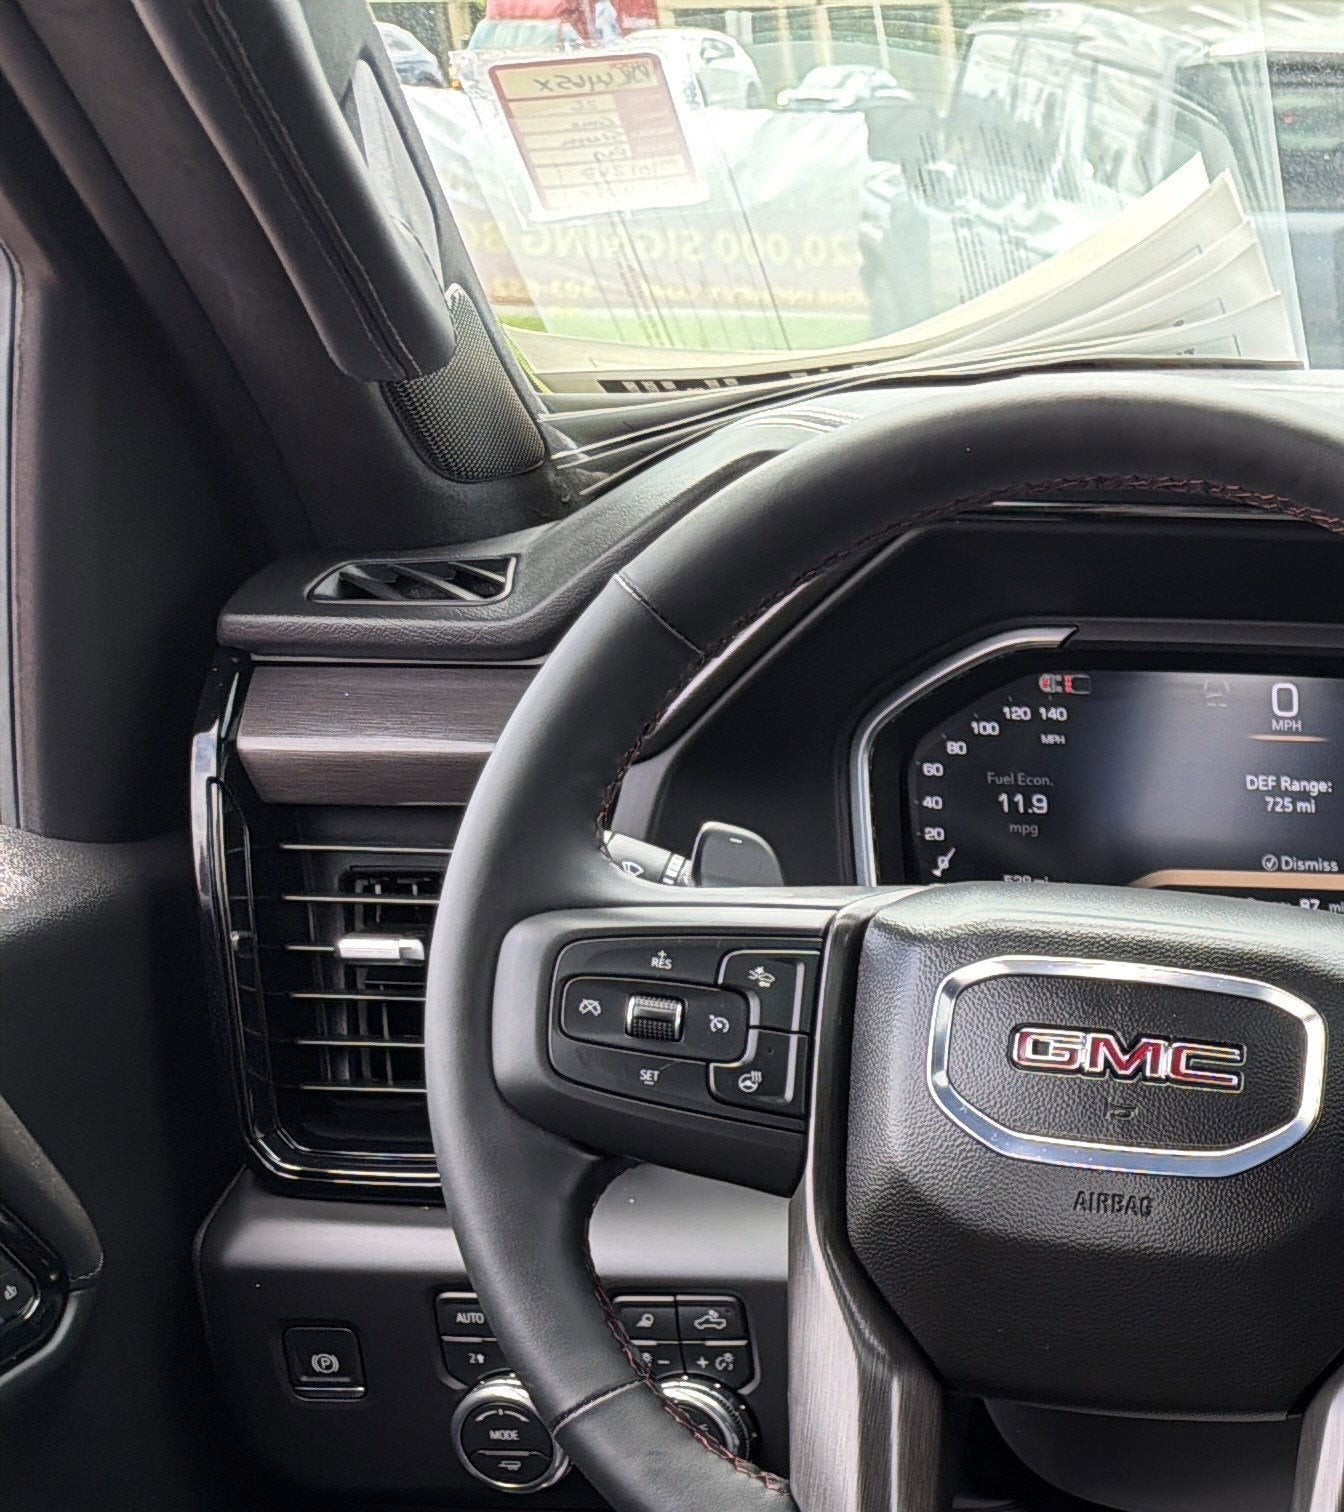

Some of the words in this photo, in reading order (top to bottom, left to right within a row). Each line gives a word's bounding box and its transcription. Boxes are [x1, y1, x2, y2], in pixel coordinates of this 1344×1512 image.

[1271, 682, 1299, 718] 0
[1002, 706, 1032, 721] 120
[1038, 706, 1068, 721] 140
[970, 720, 1000, 736] 100
[1271, 718, 1302, 732] MPH
[922, 762, 944, 777] 60
[986, 771, 1015, 785] Fuel
[1017, 772, 1055, 787] Econ.
[1245, 774, 1278, 791] DEF
[1280, 775, 1333, 797] Range:
[922, 795, 944, 811] 40
[997, 793, 1049, 815] 11.9
[1264, 796, 1293, 813] 725
[1296, 798, 1317, 814] mi
[923, 826, 945, 842] 20
[1009, 823, 1040, 839] mpg
[1280, 854, 1340, 872] Dismiss
[651, 956, 672, 970] RES
[1013, 1027, 1246, 1091] GMC
[639, 1069, 659, 1082] SET
[1073, 1190, 1154, 1217] AIRBAG
[456, 1312, 485, 1325] AUTO
[489, 1429, 521, 1442] MODE
